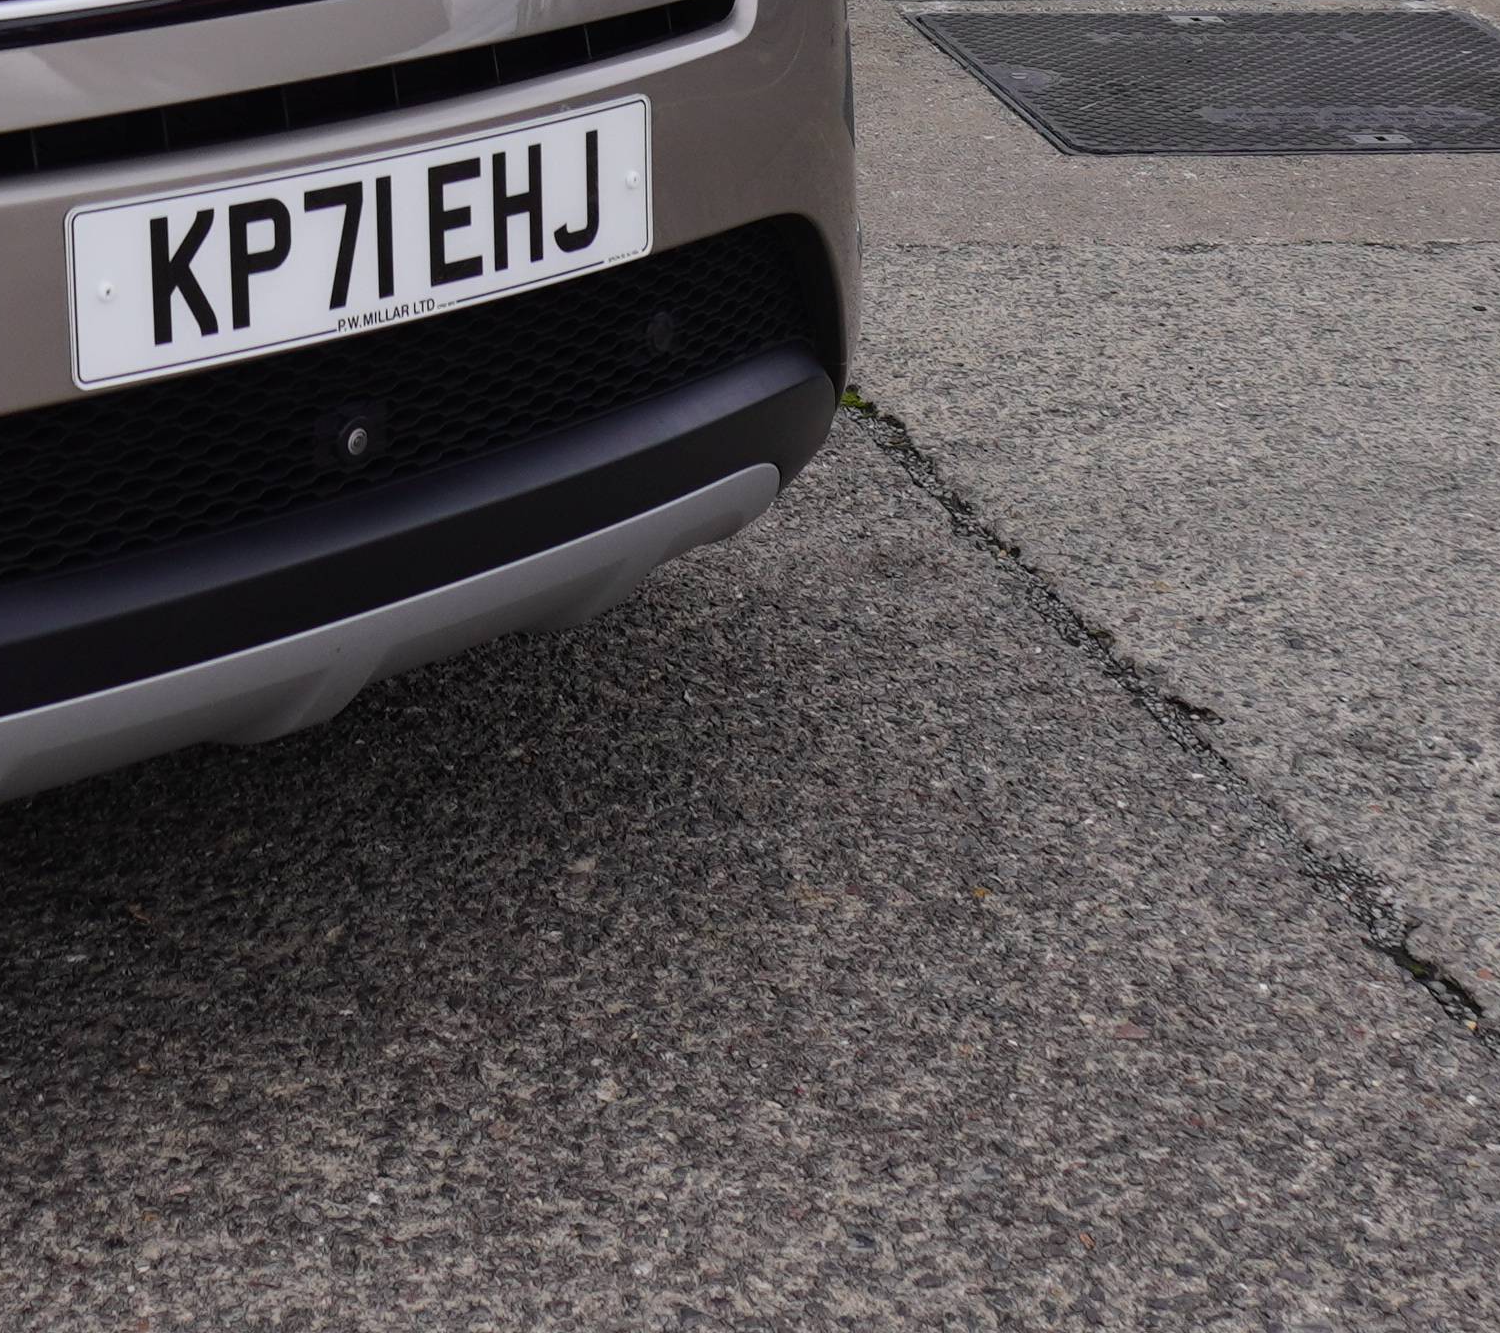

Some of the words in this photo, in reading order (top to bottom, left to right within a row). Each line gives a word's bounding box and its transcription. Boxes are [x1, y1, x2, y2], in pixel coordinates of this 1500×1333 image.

[149, 174, 395, 347] KP71
[427, 129, 600, 288] EHJ
[413, 298, 436, 314] LTD
